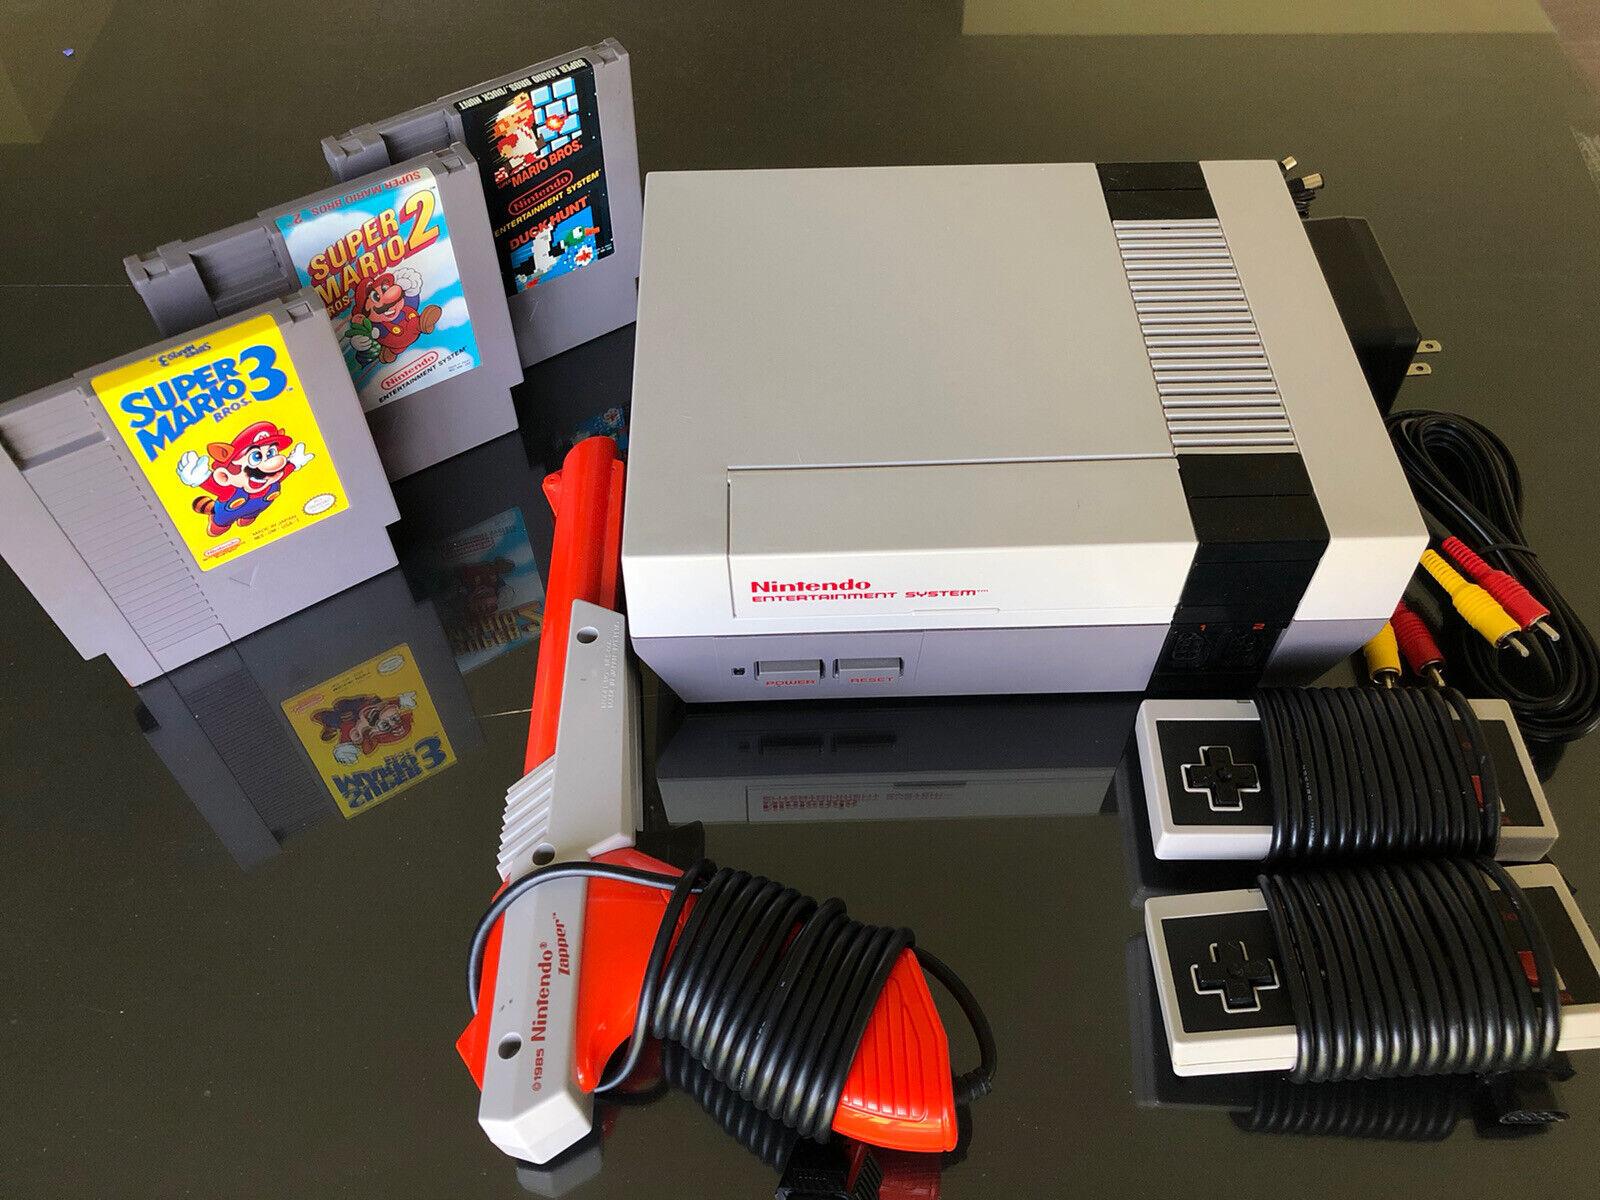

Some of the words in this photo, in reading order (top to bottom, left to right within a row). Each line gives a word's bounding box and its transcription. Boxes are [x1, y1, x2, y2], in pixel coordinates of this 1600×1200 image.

[344, 185, 382, 205] MARIO
[385, 170, 421, 189] SUPER
[511, 159, 549, 187] MARIO
[513, 175, 569, 211] Nintendo
[495, 192, 564, 237] ENTERTAINMENT
[566, 170, 600, 195] SYSTEM
[509, 220, 548, 250] DUCK
[549, 197, 587, 225] HUNT
[308, 208, 399, 280] SUPER
[313, 235, 406, 306] MARIO
[399, 190, 440, 254] 2
[120, 357, 241, 428] SUPER
[378, 365, 437, 403] ENTERTAINMENT
[438, 347, 467, 367] SYSTEM
[385, 354, 435, 390] Nintendo
[136, 378, 247, 462] MARIO
[239, 344, 288, 401] 3
[751, 578, 871, 593] Nintendo
[752, 591, 898, 603] ENTERTAINMENT
[765, 679, 816, 688] POWER
[849, 676, 894, 684] RESET
[555, 919, 570, 976] Zapper
